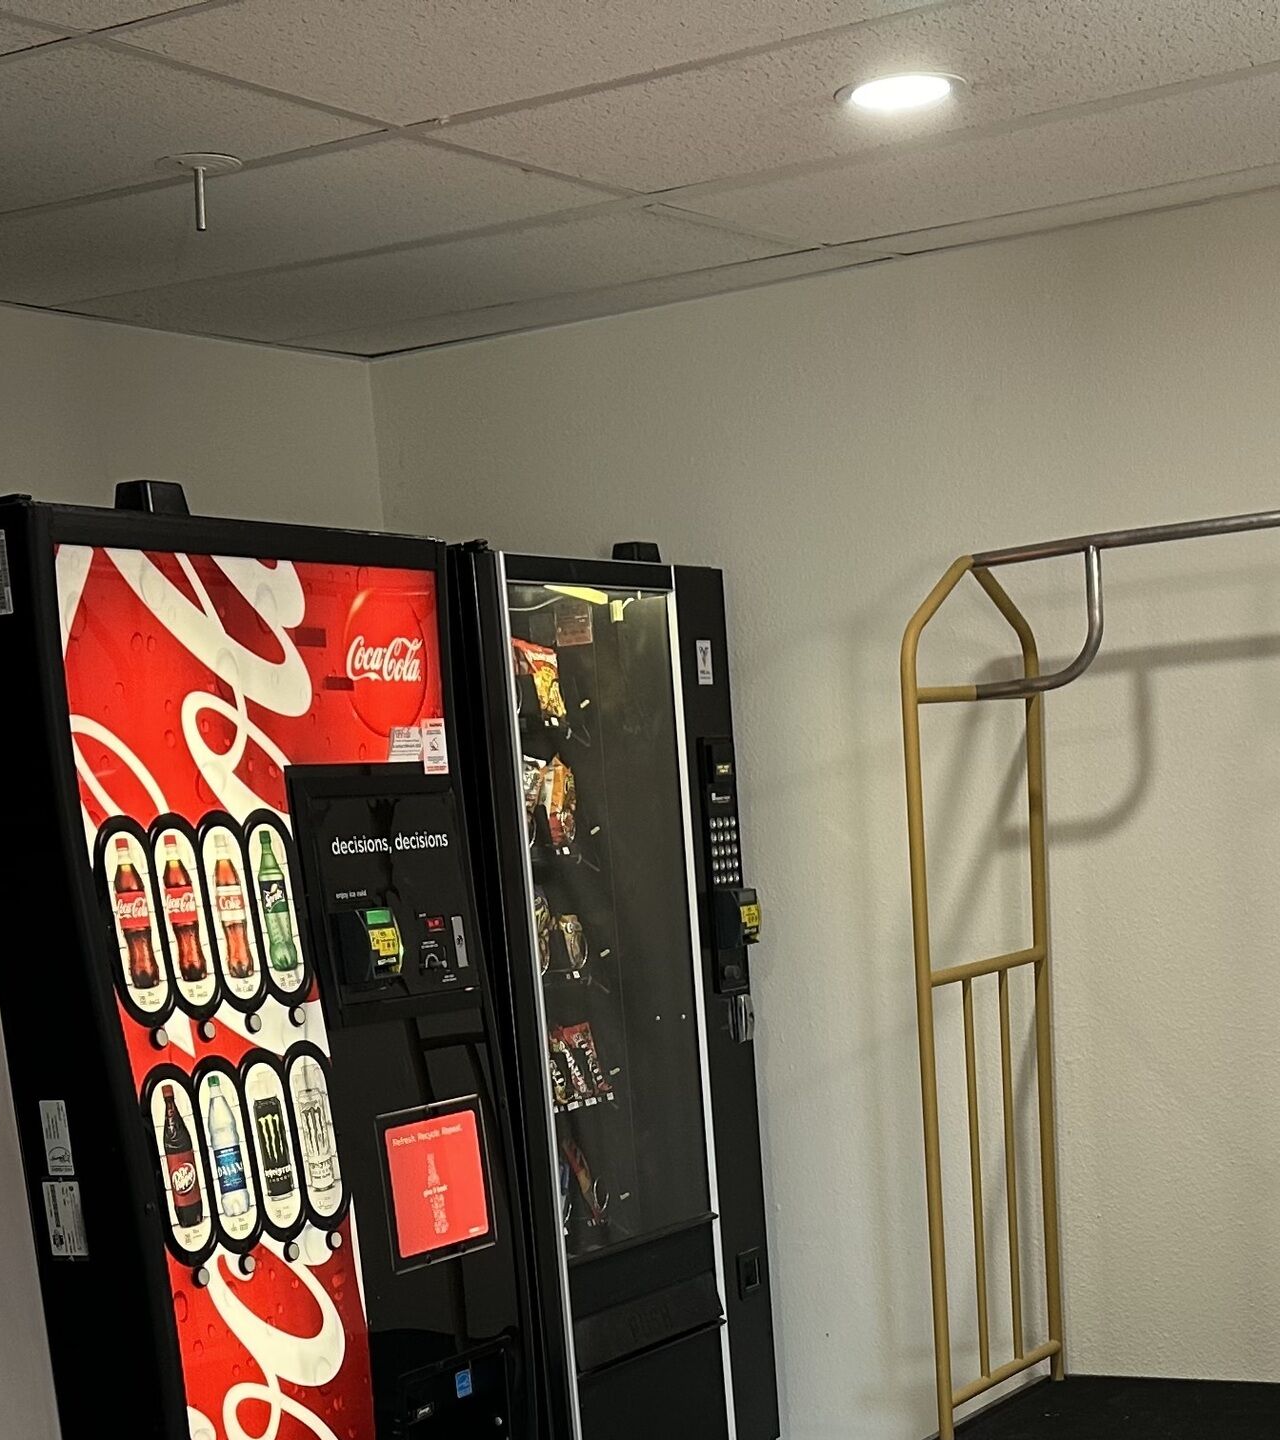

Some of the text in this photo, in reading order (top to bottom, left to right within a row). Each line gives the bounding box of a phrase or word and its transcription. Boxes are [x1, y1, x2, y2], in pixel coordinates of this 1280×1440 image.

[346, 635, 423, 682] Coca-Cola
[331, 831, 449, 855] decisions, decisions
[219, 896, 242, 910] Coke
